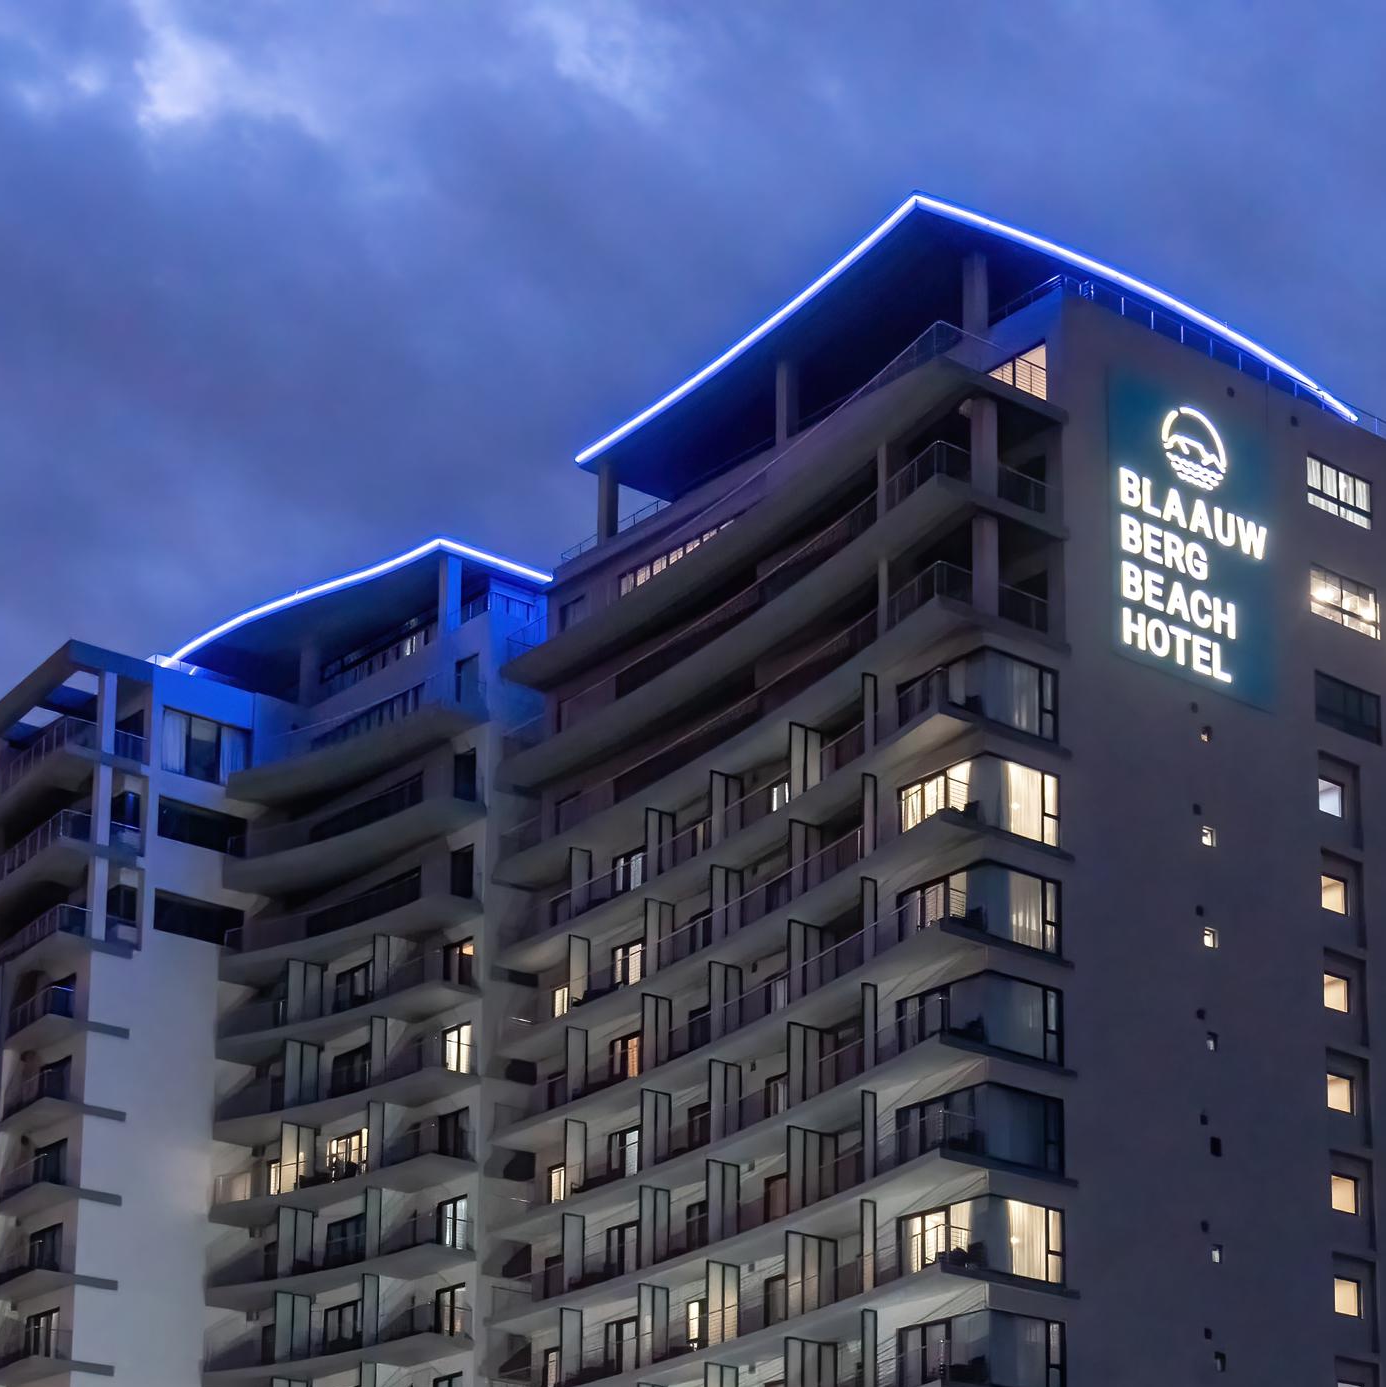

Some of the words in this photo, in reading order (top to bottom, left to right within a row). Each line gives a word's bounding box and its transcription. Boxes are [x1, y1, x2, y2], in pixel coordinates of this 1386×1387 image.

[1119, 466, 1268, 561] BLAAUW
[1120, 513, 1209, 581] BERG
[1121, 560, 1237, 640] BEACH
[1121, 606, 1232, 684] HOTEL
